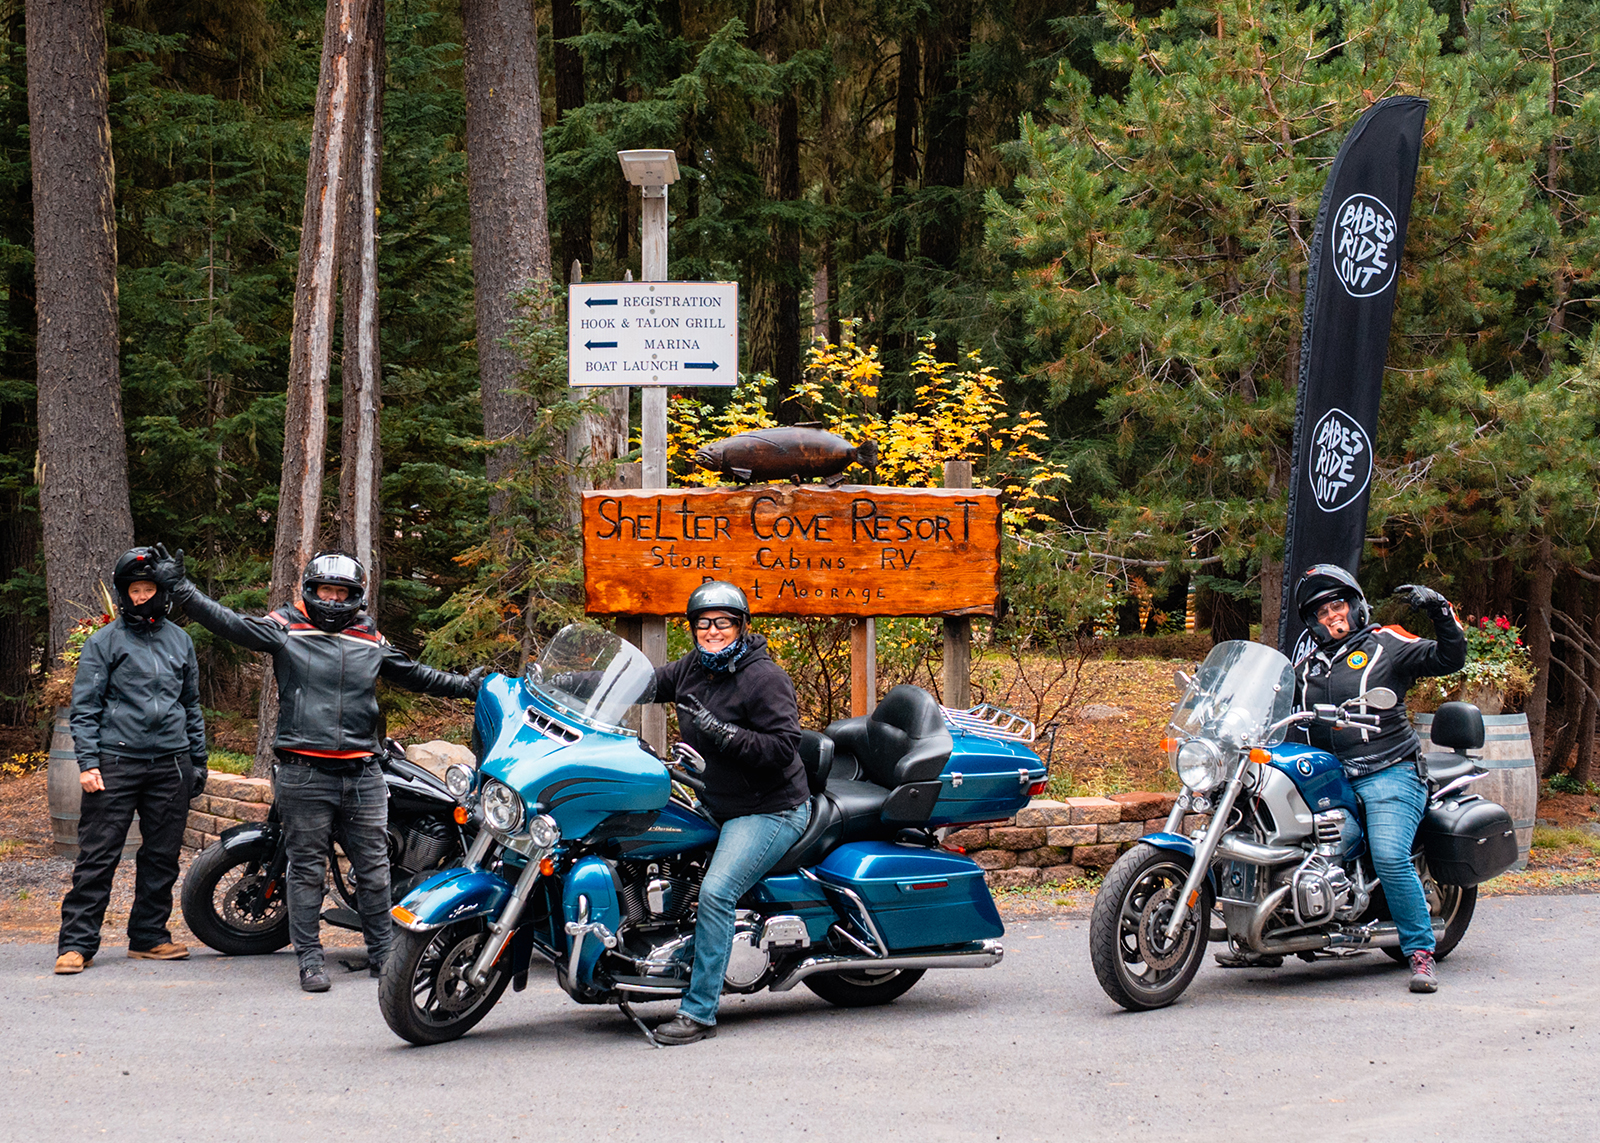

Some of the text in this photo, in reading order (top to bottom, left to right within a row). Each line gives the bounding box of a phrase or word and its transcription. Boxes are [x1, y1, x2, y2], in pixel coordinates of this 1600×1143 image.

[1340, 202, 1395, 243] BABES
[1338, 227, 1388, 270] RIDE
[1341, 256, 1382, 288] OUT
[623, 297, 722, 307] REGISTRATION
[581, 317, 726, 329] HOOK & TALON GRILL
[644, 339, 700, 350] MARINA
[585, 360, 678, 371] BOAT LAUNCH
[1316, 416, 1364, 455] BABES
[1315, 444, 1355, 482] RIDE
[1317, 474, 1348, 503] OUT
[851, 498, 979, 543] RESORT
[881, 547, 917, 570] RV
